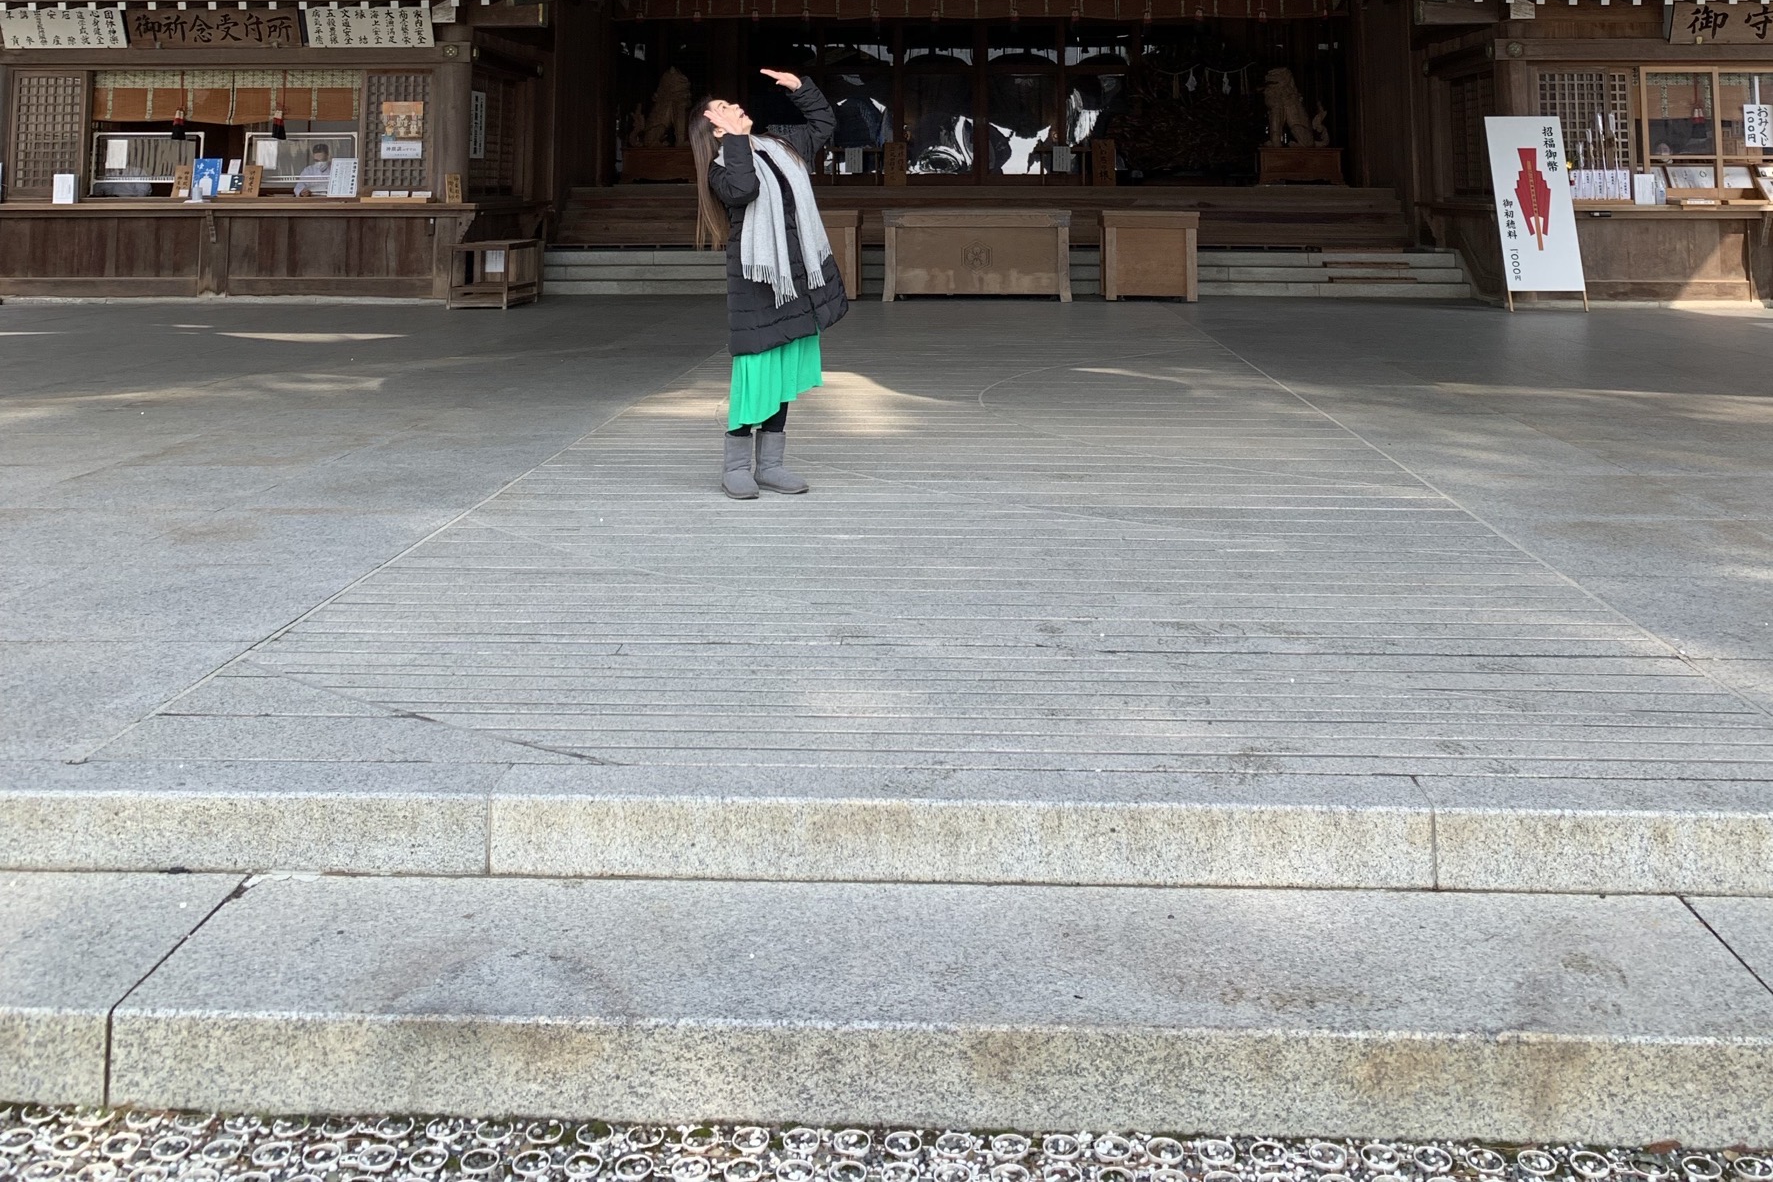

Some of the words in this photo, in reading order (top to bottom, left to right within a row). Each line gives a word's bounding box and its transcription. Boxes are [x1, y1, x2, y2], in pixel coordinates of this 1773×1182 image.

[134, 13, 292, 43] 御祈念受付所
[1757, 106, 1770, 147] おみくじ
[1502, 199, 1518, 239] 御初穂料
